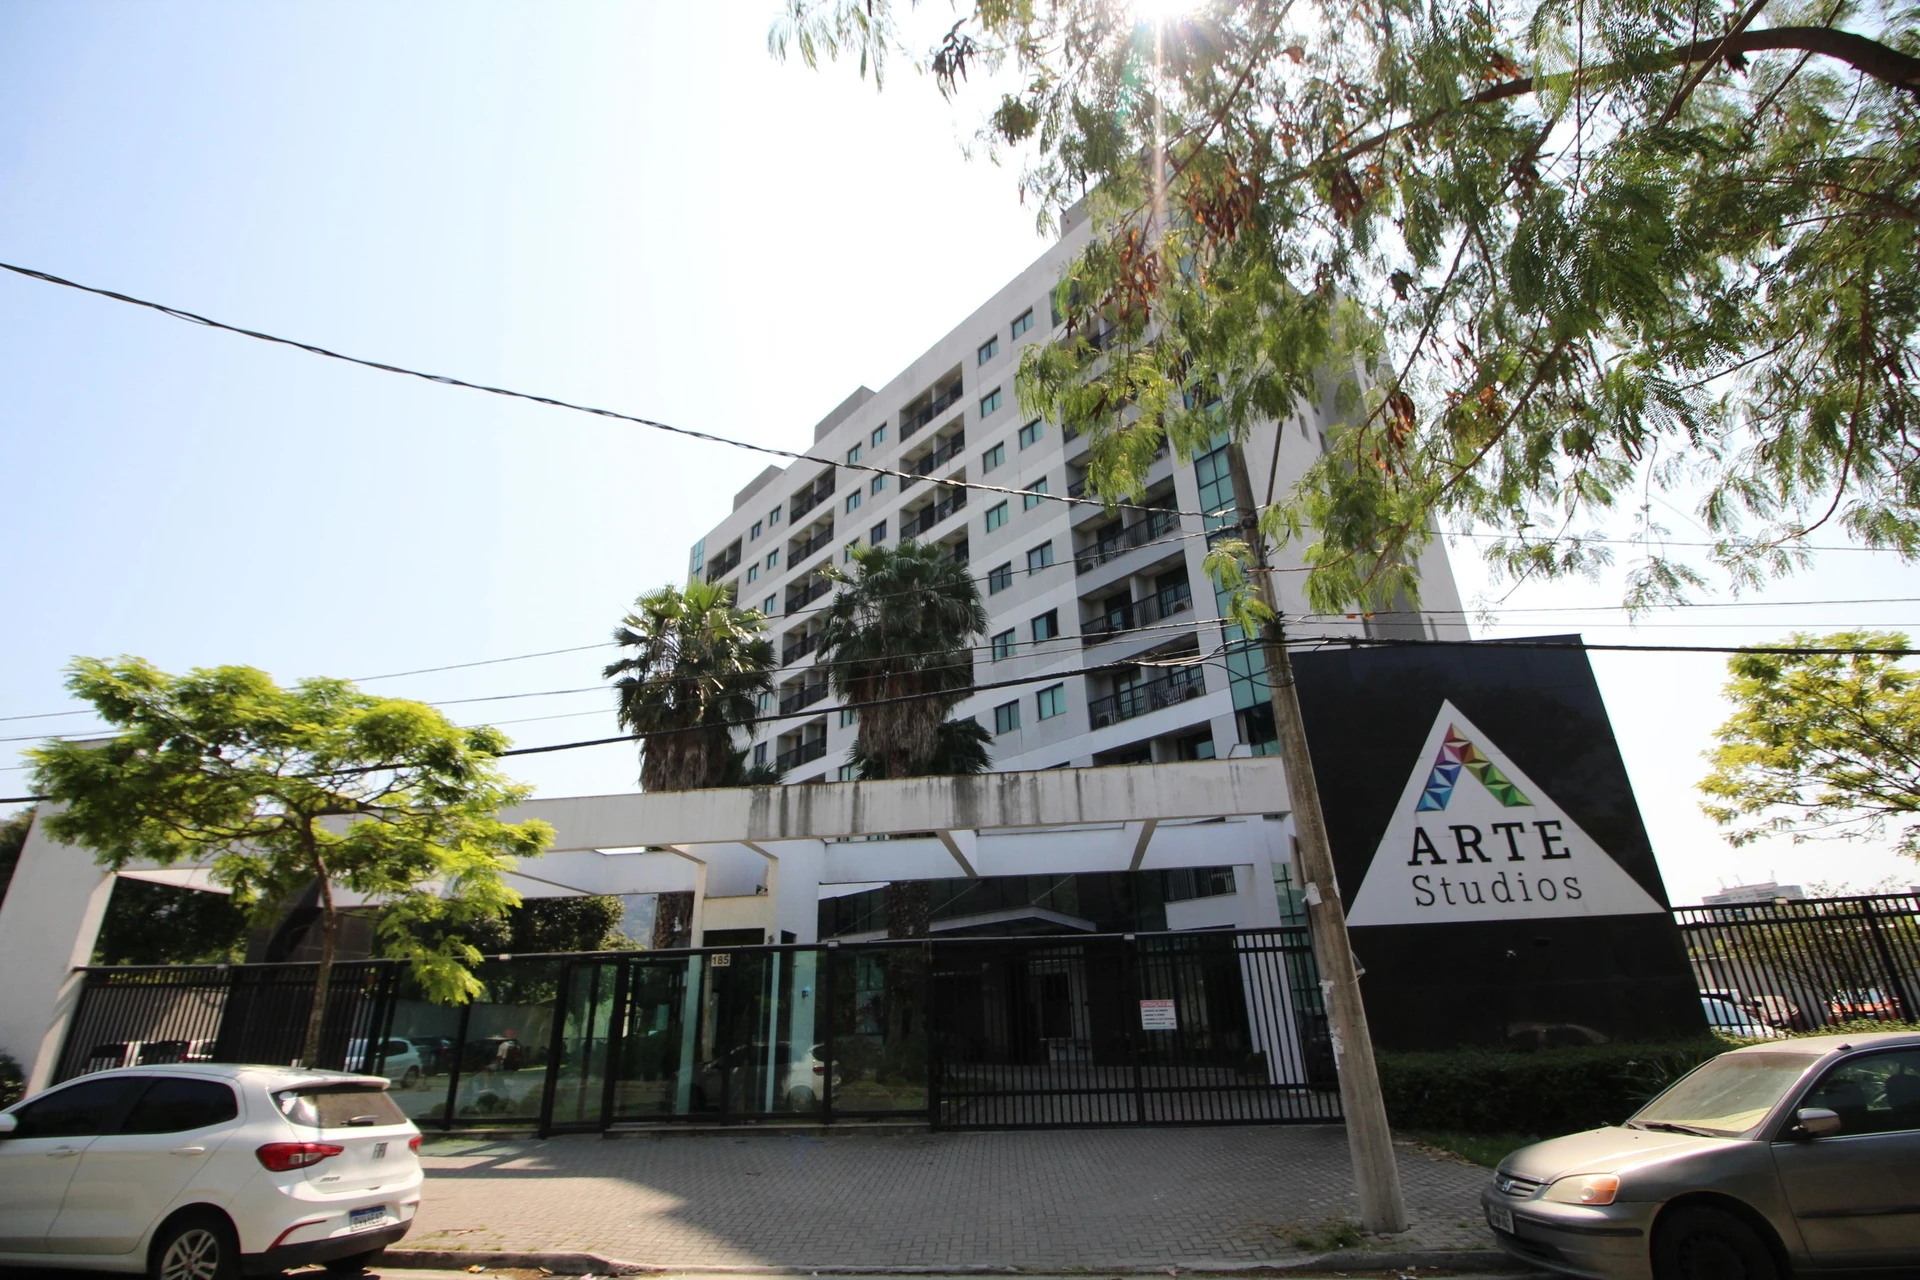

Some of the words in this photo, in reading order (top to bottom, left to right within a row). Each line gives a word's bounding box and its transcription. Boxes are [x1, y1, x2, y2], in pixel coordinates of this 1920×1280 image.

[1407, 820, 1572, 867] ARTE
[1411, 871, 1582, 907] Studios
[712, 955, 729, 965] 185
